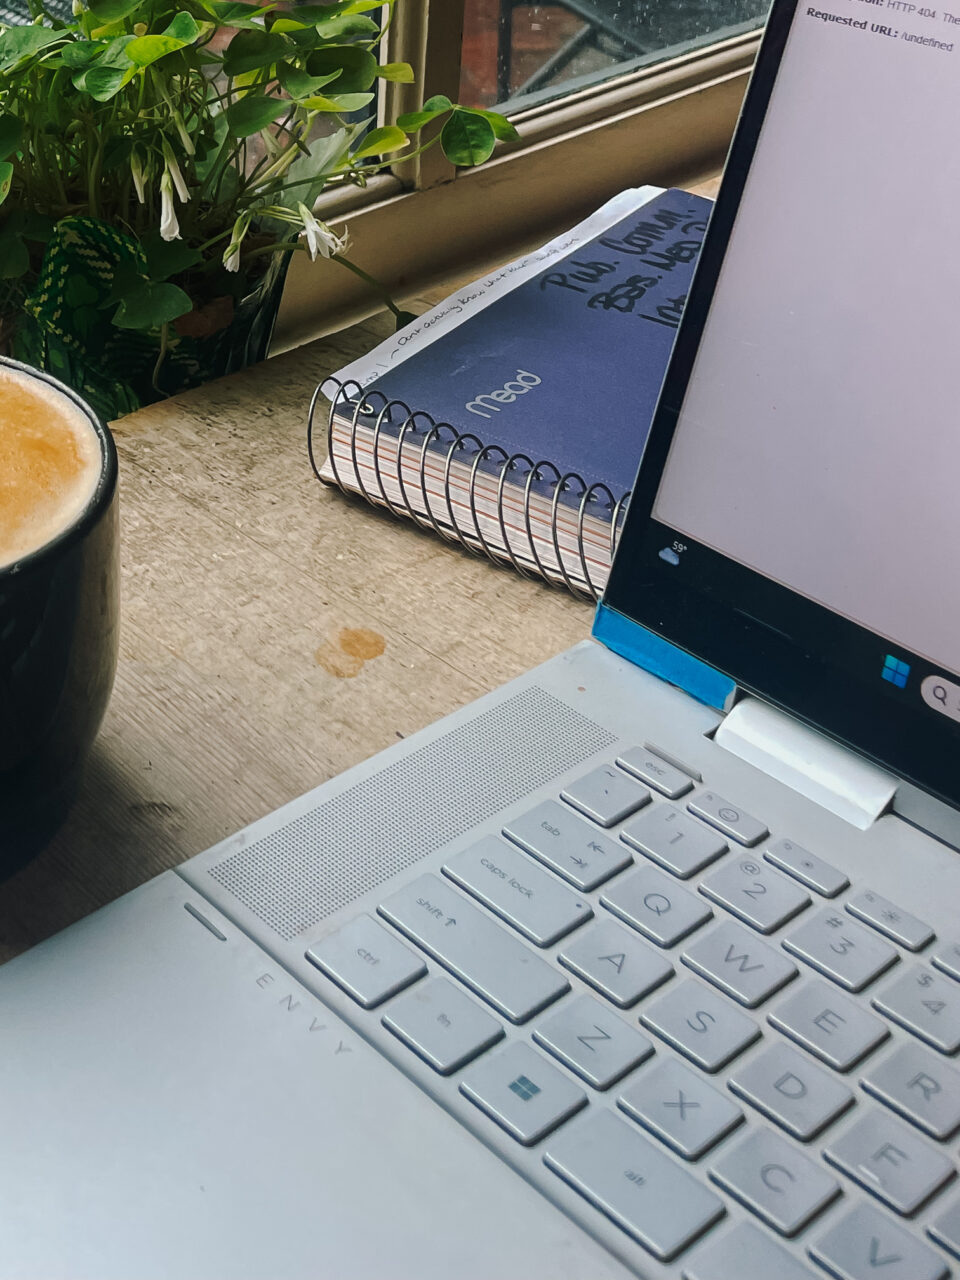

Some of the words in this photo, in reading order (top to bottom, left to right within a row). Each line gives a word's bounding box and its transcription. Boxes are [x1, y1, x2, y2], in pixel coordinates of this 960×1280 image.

[887, 0, 916, 14] HTTP
[806, 7, 868, 30] Requested
[870, 23, 899, 38] URL:
[901, 31, 954, 52] /undefined
[541, 820, 561, 838] tab
[669, 831, 685, 845] 1
[480, 856, 507, 881] caps
[507, 876, 534, 899] lock
[740, 860, 761, 877] @
[643, 892, 672, 917] Q
[743, 883, 768, 901] 2
[416, 896, 445, 921] shift
[356, 947, 381, 966] ctrl
[830, 935, 856, 955] 3
[598, 952, 627, 974] A
[724, 943, 765, 973] W
[255, 972, 352, 1056] ENVY
[921, 1000, 947, 1016] 4
[685, 1011, 718, 1034] S
[813, 1008, 847, 1035] E
[576, 1024, 611, 1053] Z
[773, 1071, 807, 1100] D
[906, 1071, 943, 1102] R
[663, 1089, 700, 1119] X
[870, 1142, 910, 1168] F
[623, 1167, 648, 1187] alt
[760, 1163, 796, 1194] C
[868, 1236, 904, 1268] V
